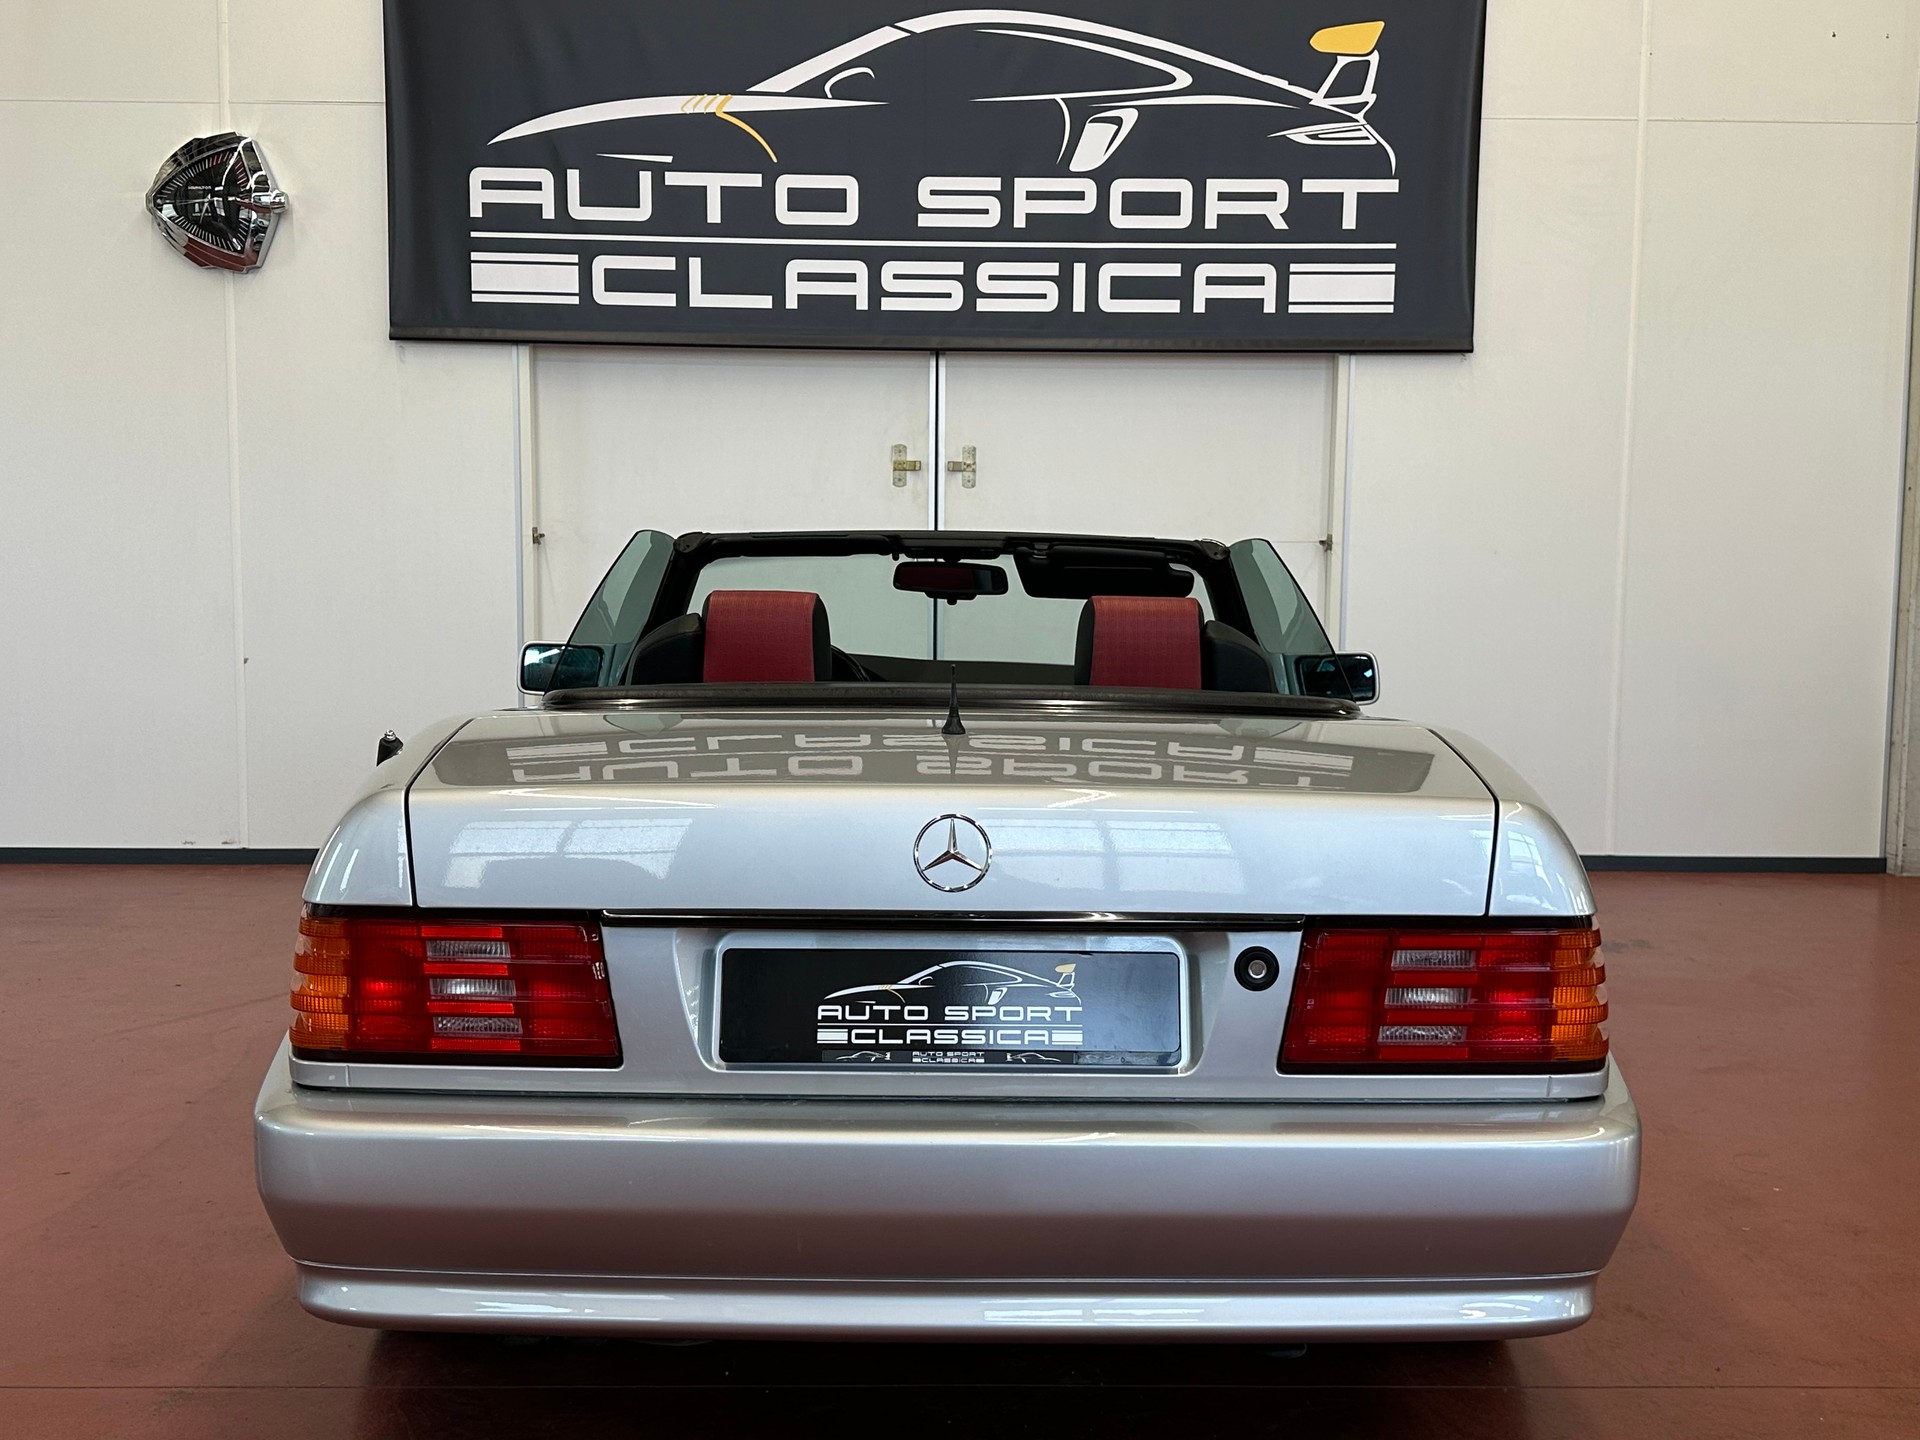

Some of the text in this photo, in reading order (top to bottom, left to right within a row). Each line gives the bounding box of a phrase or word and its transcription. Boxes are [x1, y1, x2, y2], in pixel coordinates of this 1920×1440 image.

[469, 166, 1400, 230] AUTO SPORT
[591, 254, 1277, 314] CLASSICA
[817, 1005, 1084, 1022] AUTO SPORT
[850, 1028, 1050, 1046] CLASSICA
